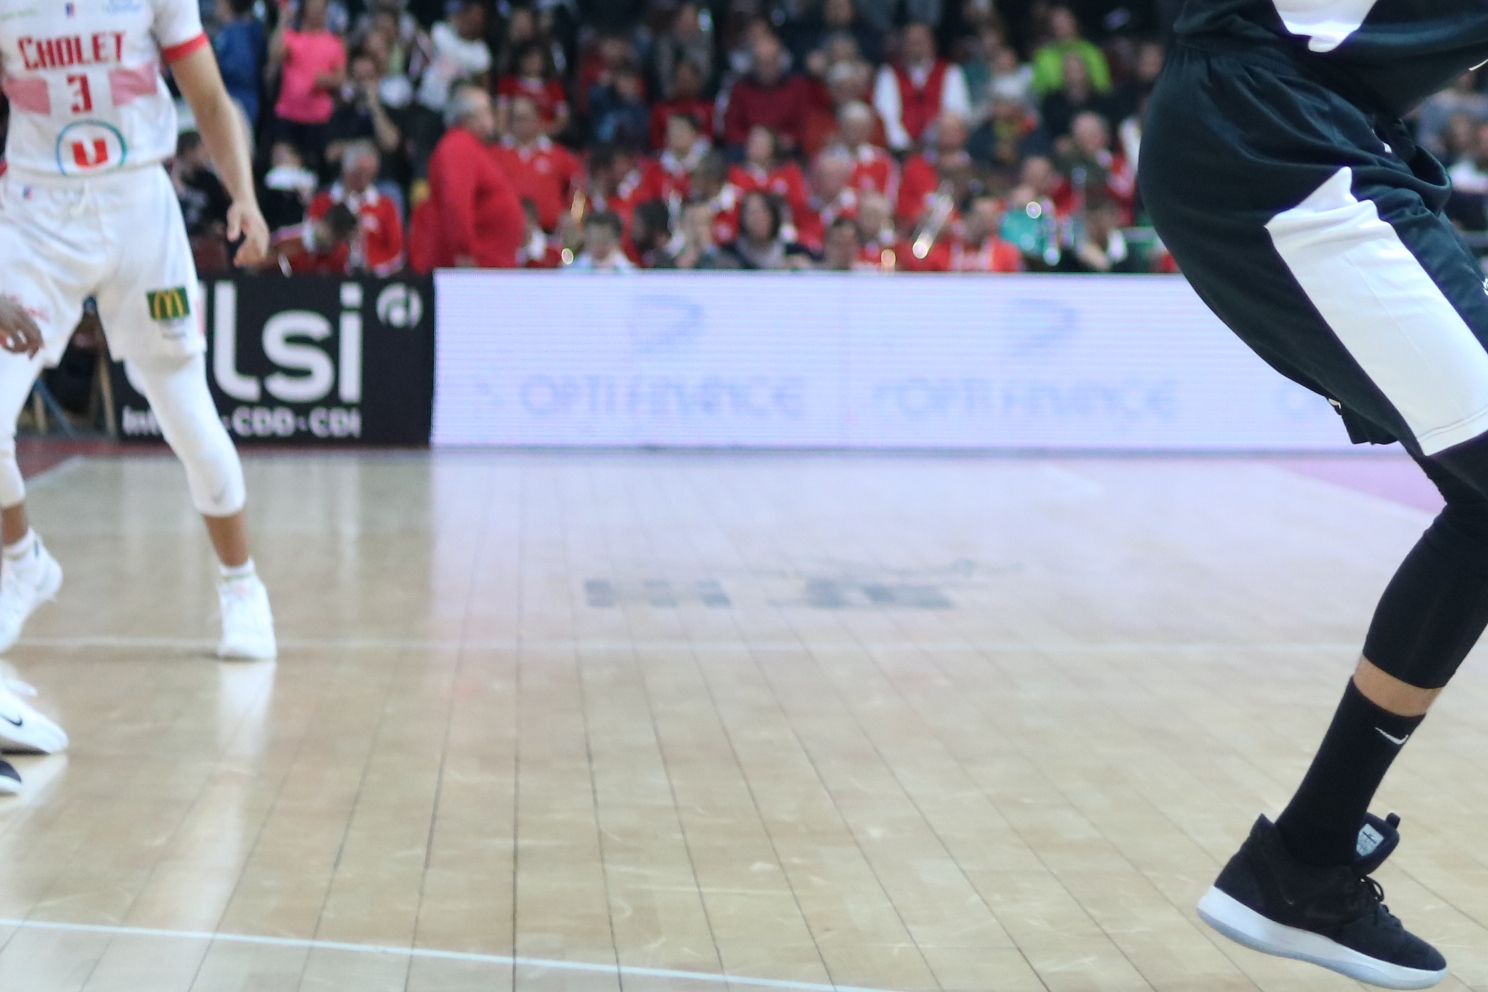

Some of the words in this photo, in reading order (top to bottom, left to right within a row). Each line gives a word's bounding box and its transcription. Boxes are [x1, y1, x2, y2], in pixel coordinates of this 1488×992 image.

[17, 31, 126, 71] CHOLET
[67, 73, 93, 115] 3
[71, 137, 109, 169] U
